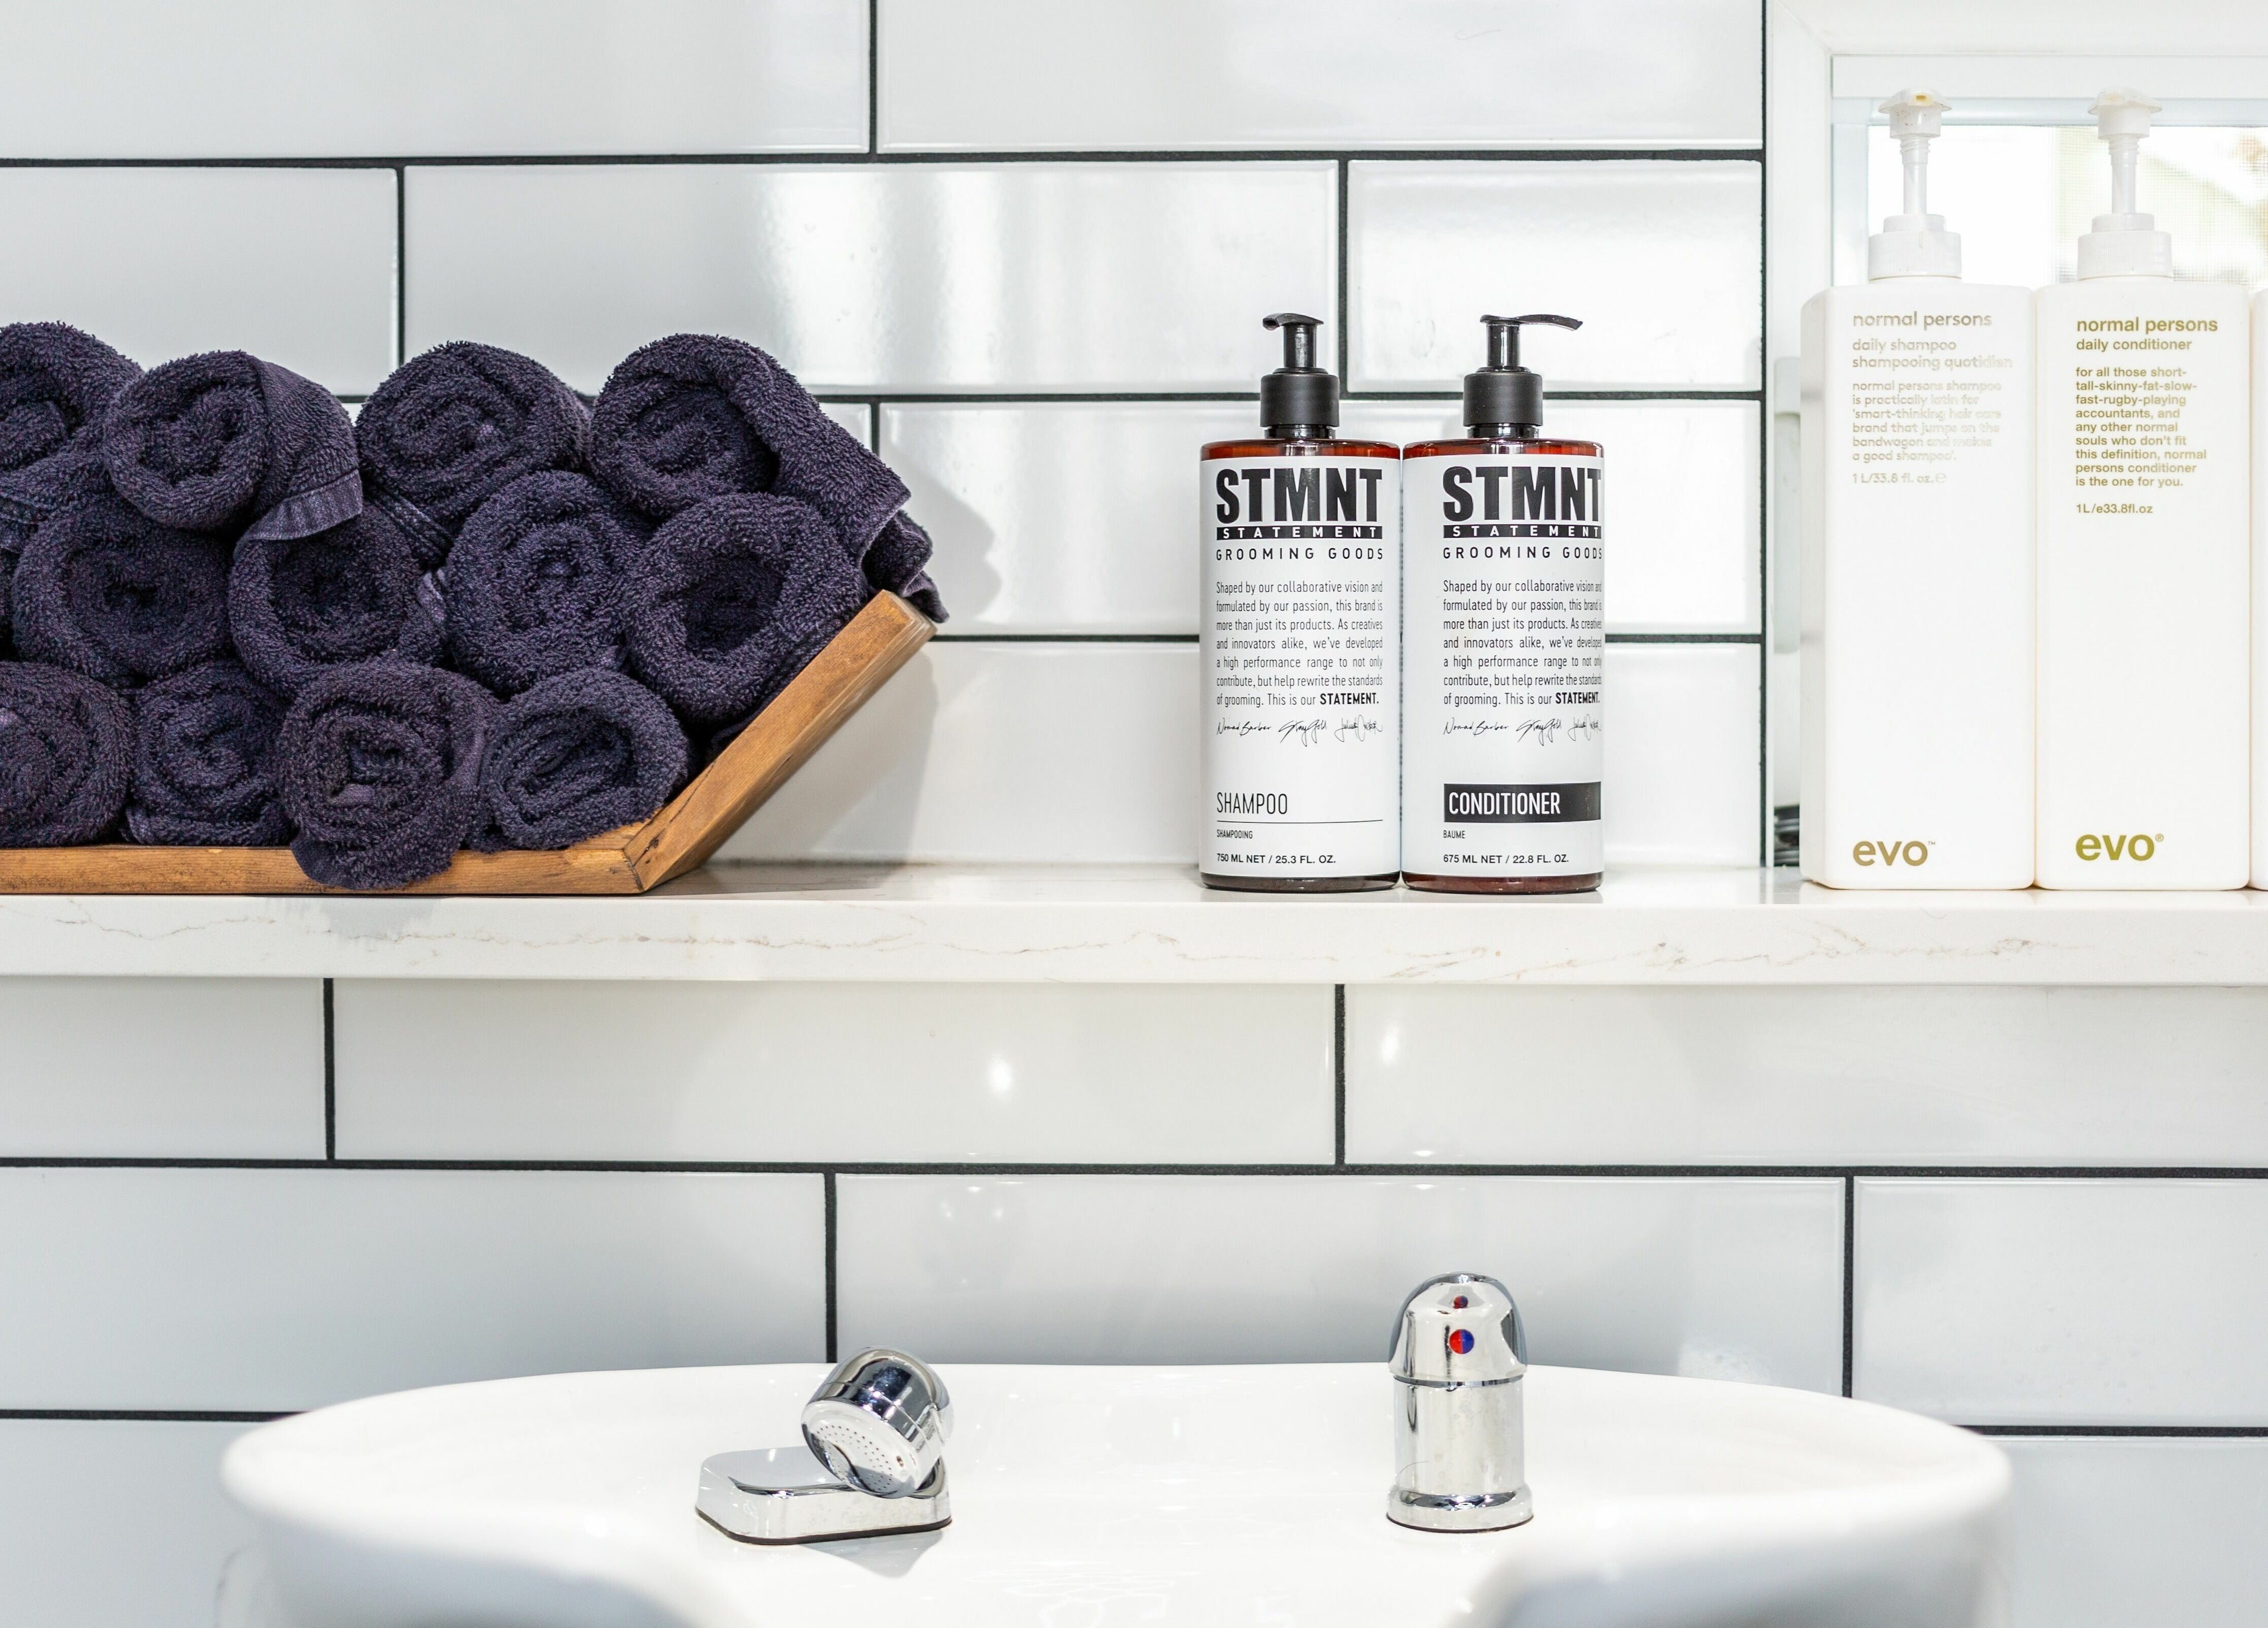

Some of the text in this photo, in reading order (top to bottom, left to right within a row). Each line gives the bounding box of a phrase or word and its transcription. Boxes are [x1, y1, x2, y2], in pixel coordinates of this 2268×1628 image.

[1853, 311, 1992, 331] normal persons
[2077, 317, 2218, 334] normal persons
[1852, 338, 1957, 354] daily shampoo
[2077, 338, 2192, 352] daily conditioner
[1852, 355, 1940, 371] shampooing
[2076, 367, 2186, 377] for all those short-
[1853, 380, 1894, 390] normal
[2075, 381, 2197, 392] tall-skinny-fat-slow-
[1853, 394, 1928, 408] is practically
[2075, 395, 2186, 406] fast-rugby-playing
[2076, 408, 2180, 419] accountants, and
[1853, 422, 1918, 432] brand that
[2075, 422, 2178, 434] any other normal
[1853, 437, 1923, 450] bandwagon
[2076, 436, 2107, 445] souls
[2111, 436, 2136, 445] who
[2174, 436, 2186, 445] fit
[1863, 450, 1893, 463] good
[2075, 449, 2207, 460] this definition, normal
[2076, 463, 2197, 474] persons conditioner
[2076, 476, 2085, 486] is
[2089, 477, 2108, 486] the
[2137, 477, 2155, 486] for
[2158, 478, 2183, 488] you.
[1216, 468, 1382, 524] STMNT
[1443, 466, 1601, 522] STMNT
[1223, 527, 1376, 539] STATEMENT
[1453, 526, 1598, 537] STATEMENT
[1217, 548, 1382, 561] GROOMING GOODS
[1443, 546, 1601, 559] GROOMING GOODS
[1217, 581, 1383, 595] Shaped by our collaborative vision and
[1443, 580, 1477, 594] Shaped
[1481, 579, 1492, 594] by
[1495, 583, 1511, 591] our
[1516, 579, 1574, 591] collaborative
[1217, 599, 1375, 614] formulated by our passion, this brand
[1443, 598, 1582, 613] formulated by our passion, this
[1217, 618, 1383, 633] more than just its products. As creatives
[1443, 617, 1579, 631] more than just its products. As
[1217, 637, 1382, 650] and innovators alike, we've developed
[1443, 636, 1572, 650] and innovators alike, we've
[1224, 655, 1383, 670] high performance range to not only
[1454, 655, 1578, 670] high performance range to
[1217, 674, 1383, 689] contribute, but help rewrite the standards
[1444, 673, 1577, 688] contribute, but help rewrite the
[1217, 693, 1223, 705] of
[1225, 693, 1263, 708] grooming.
[1267, 693, 1286, 705] This
[1290, 693, 1297, 705] is
[1320, 693, 1379, 705] STATEMENT.
[1444, 692, 1599, 707] of grooming. This is our STATEMENT.
[1217, 792, 1287, 814] SHAMPOO
[1449, 792, 1560, 815] CONDITIONER
[1217, 829, 1253, 839] SHAMPOOING
[1443, 830, 1465, 839] BAUME
[1853, 841, 1928, 866] evo
[2075, 834, 2155, 861] evo
[1217, 853, 1228, 862] 750
[1231, 854, 1243, 862] ML
[1247, 855, 1266, 863] NET
[1276, 855, 1296, 864] 25.3
[1300, 855, 1315, 864] FL.
[1443, 854, 1459, 862] 675
[1462, 855, 1477, 863] ML
[1537, 855, 1551, 863] FL.
[1555, 854, 1569, 862] OZ.
